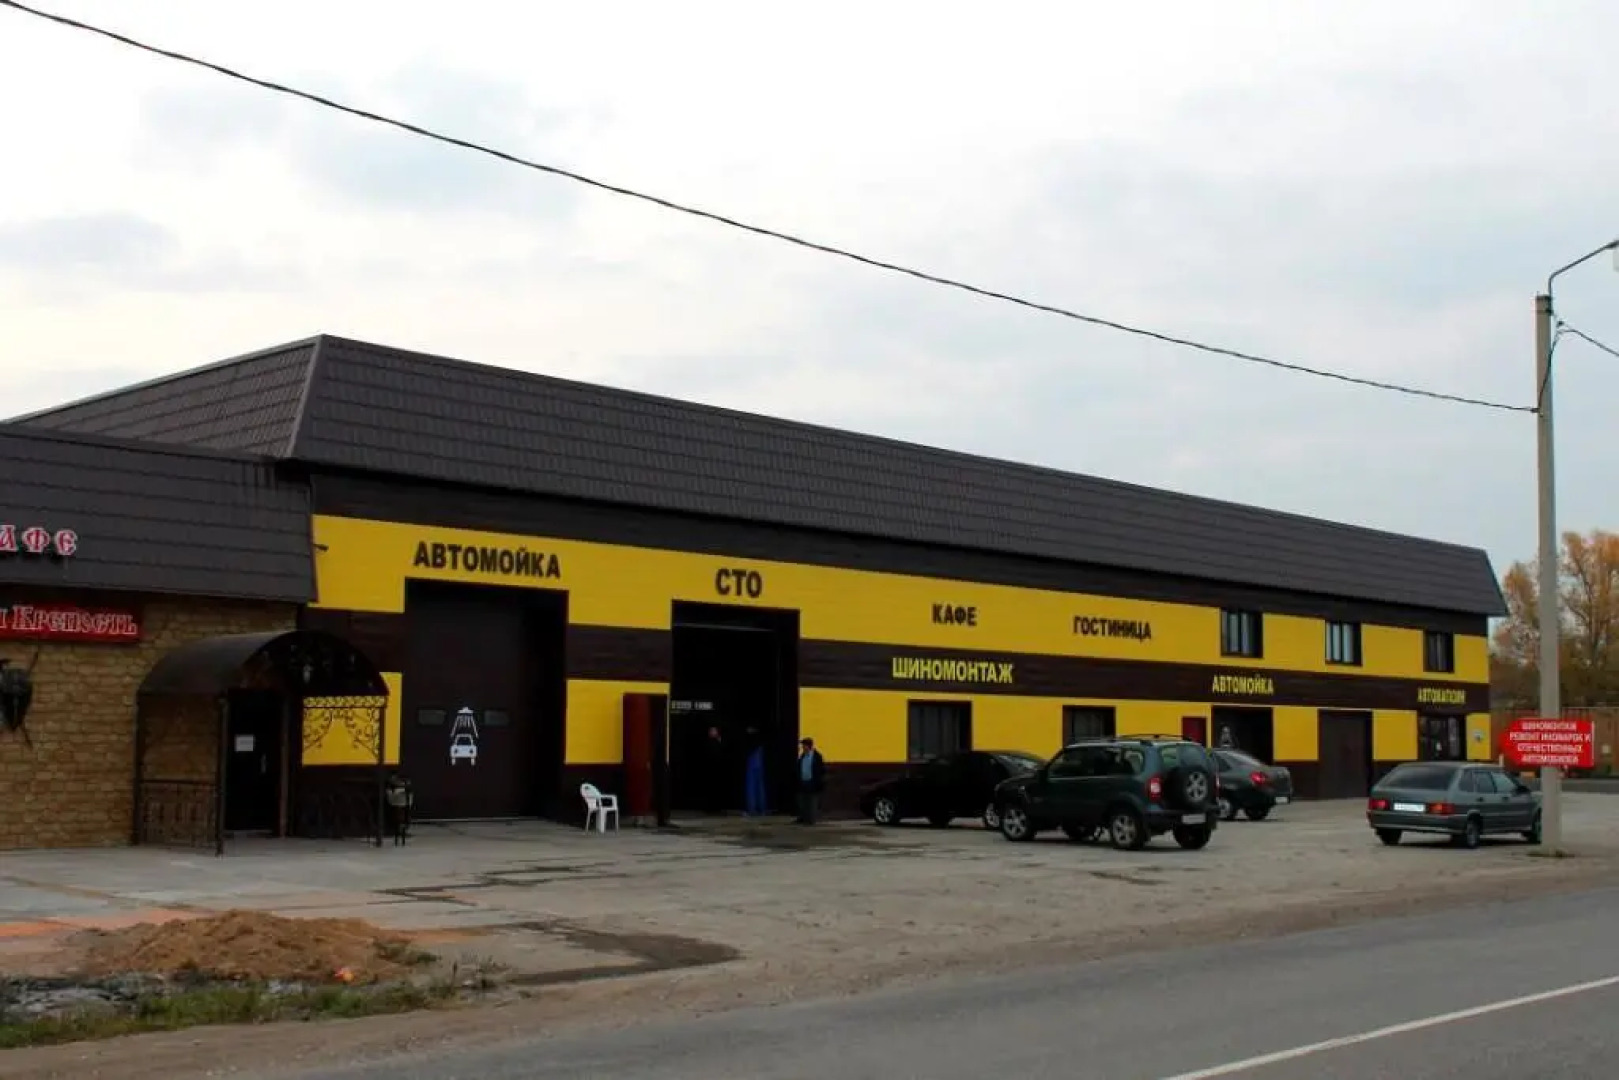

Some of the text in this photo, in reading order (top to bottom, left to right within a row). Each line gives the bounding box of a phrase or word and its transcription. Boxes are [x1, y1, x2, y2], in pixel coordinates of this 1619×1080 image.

[414, 541, 561, 579] АВТОМОЙКА
[716, 568, 763, 598] СТО
[931, 603, 977, 627] КАФЕ
[1073, 616, 1152, 641] ГОСТИНИЦА
[892, 657, 1014, 684] ШИНОМОНТАЖ
[1212, 673, 1274, 695] АВТОМОЙКА
